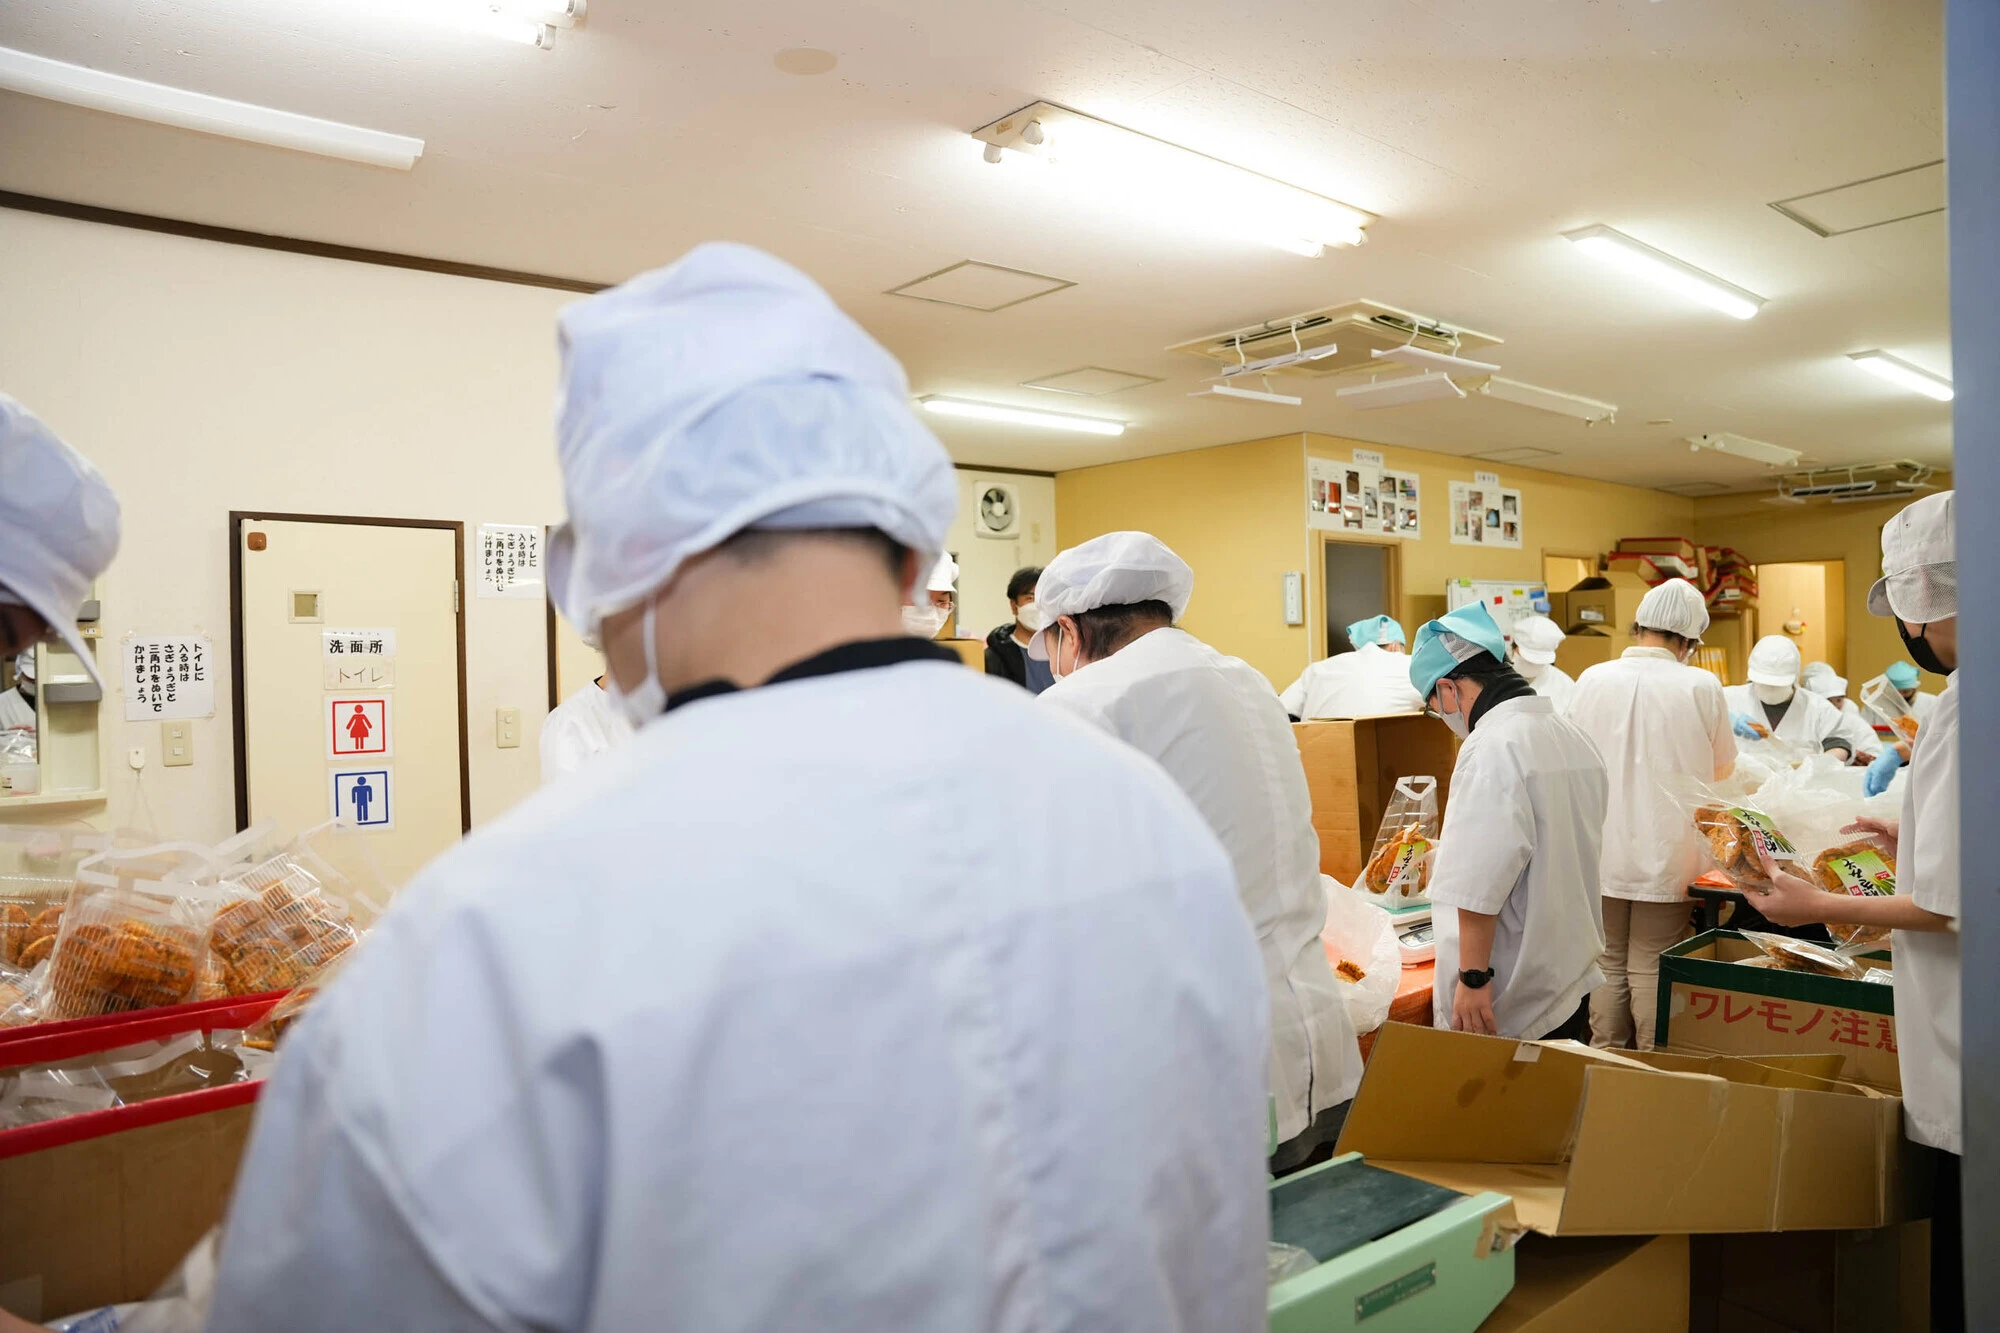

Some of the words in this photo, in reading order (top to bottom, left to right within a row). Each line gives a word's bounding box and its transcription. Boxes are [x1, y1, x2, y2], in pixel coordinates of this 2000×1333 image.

[178, 643, 190, 683] 入る時は
[193, 643, 205, 682] トイレに
[329, 639, 384, 654] 洗面所
[133, 644, 148, 704] かけましょう
[148, 643, 162, 713] 三角巾をぬいで
[163, 643, 177, 703] さぎょうぎと
[338, 666, 384, 683] トイレ
